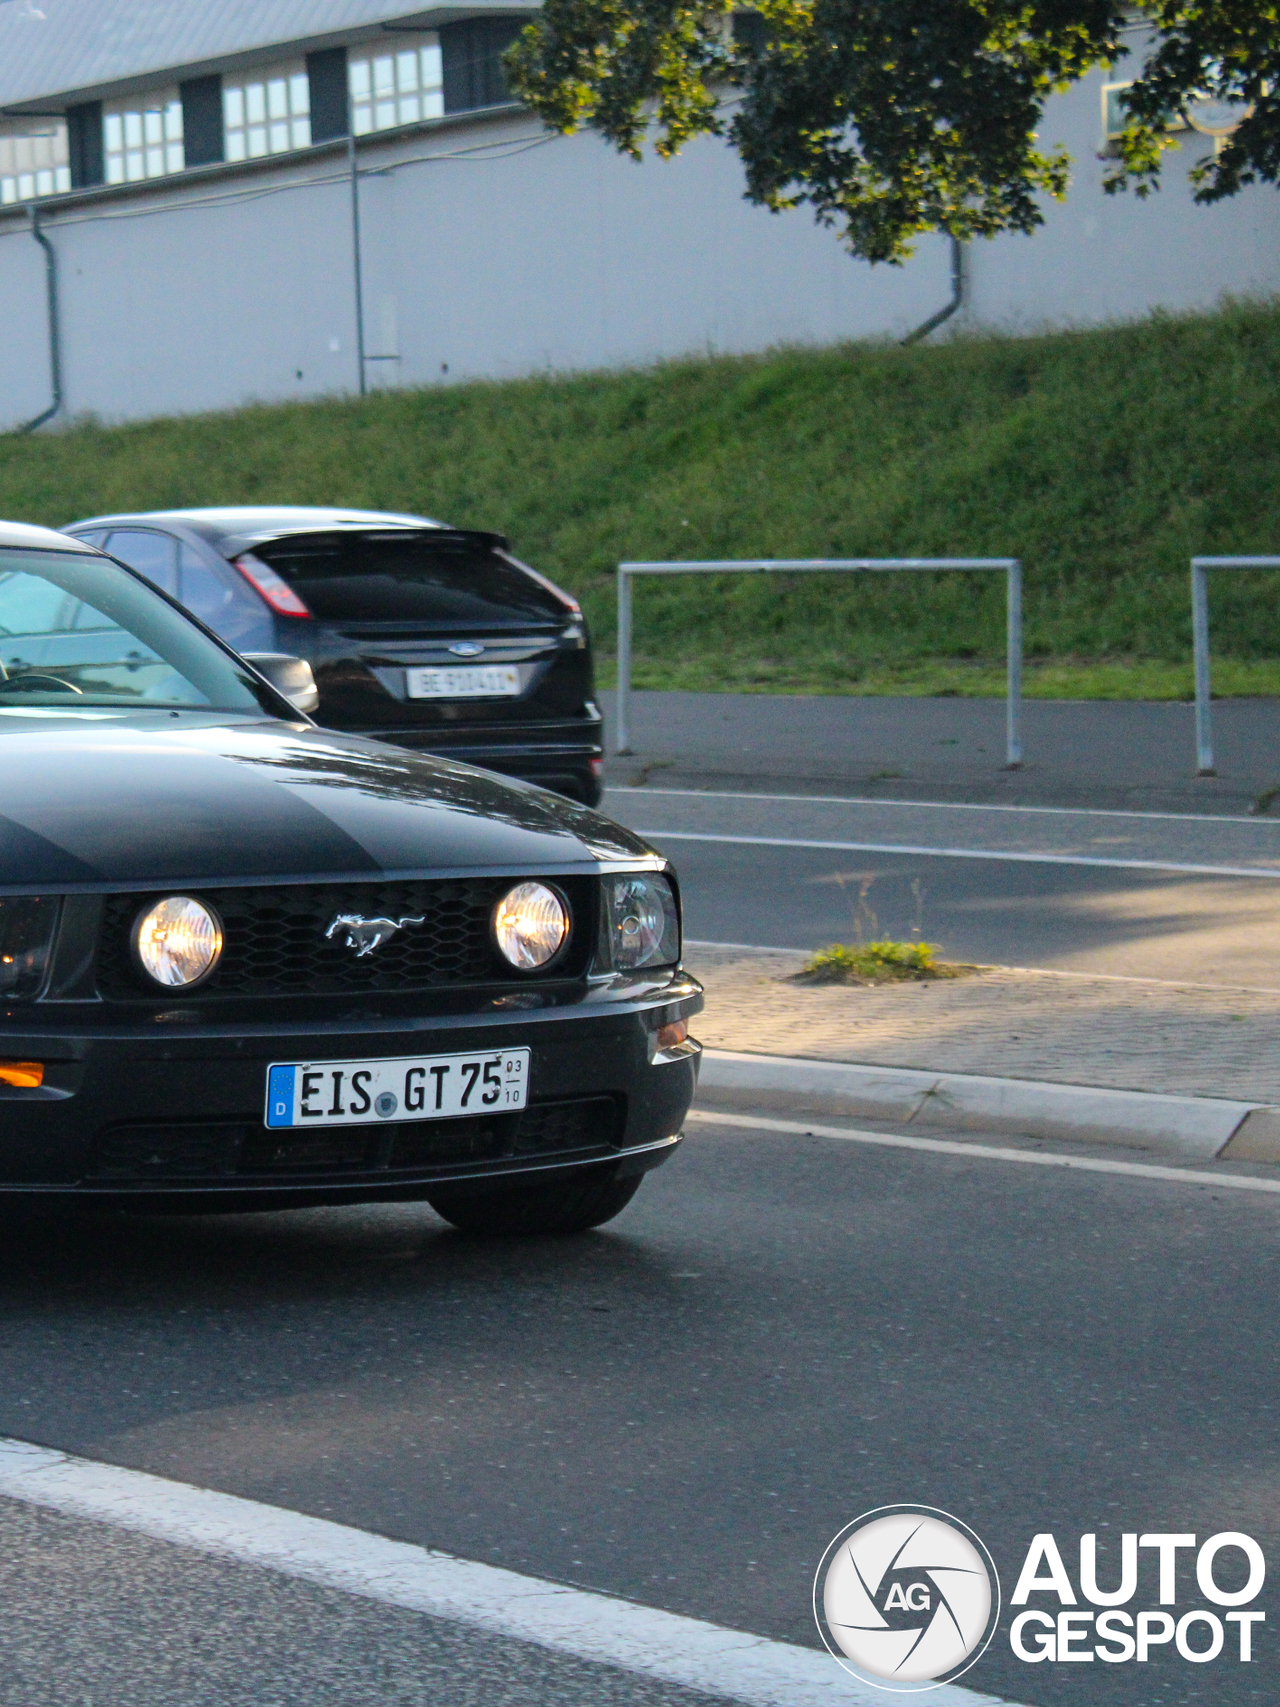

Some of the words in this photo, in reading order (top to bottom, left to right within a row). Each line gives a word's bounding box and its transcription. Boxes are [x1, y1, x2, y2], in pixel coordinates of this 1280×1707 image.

[506, 1060, 522, 1072] 03
[301, 1070, 372, 1117] EIS
[404, 1065, 450, 1111] GT
[461, 1058, 502, 1107] 75
[506, 1090, 520, 1103] 10
[275, 1102, 286, 1116] D
